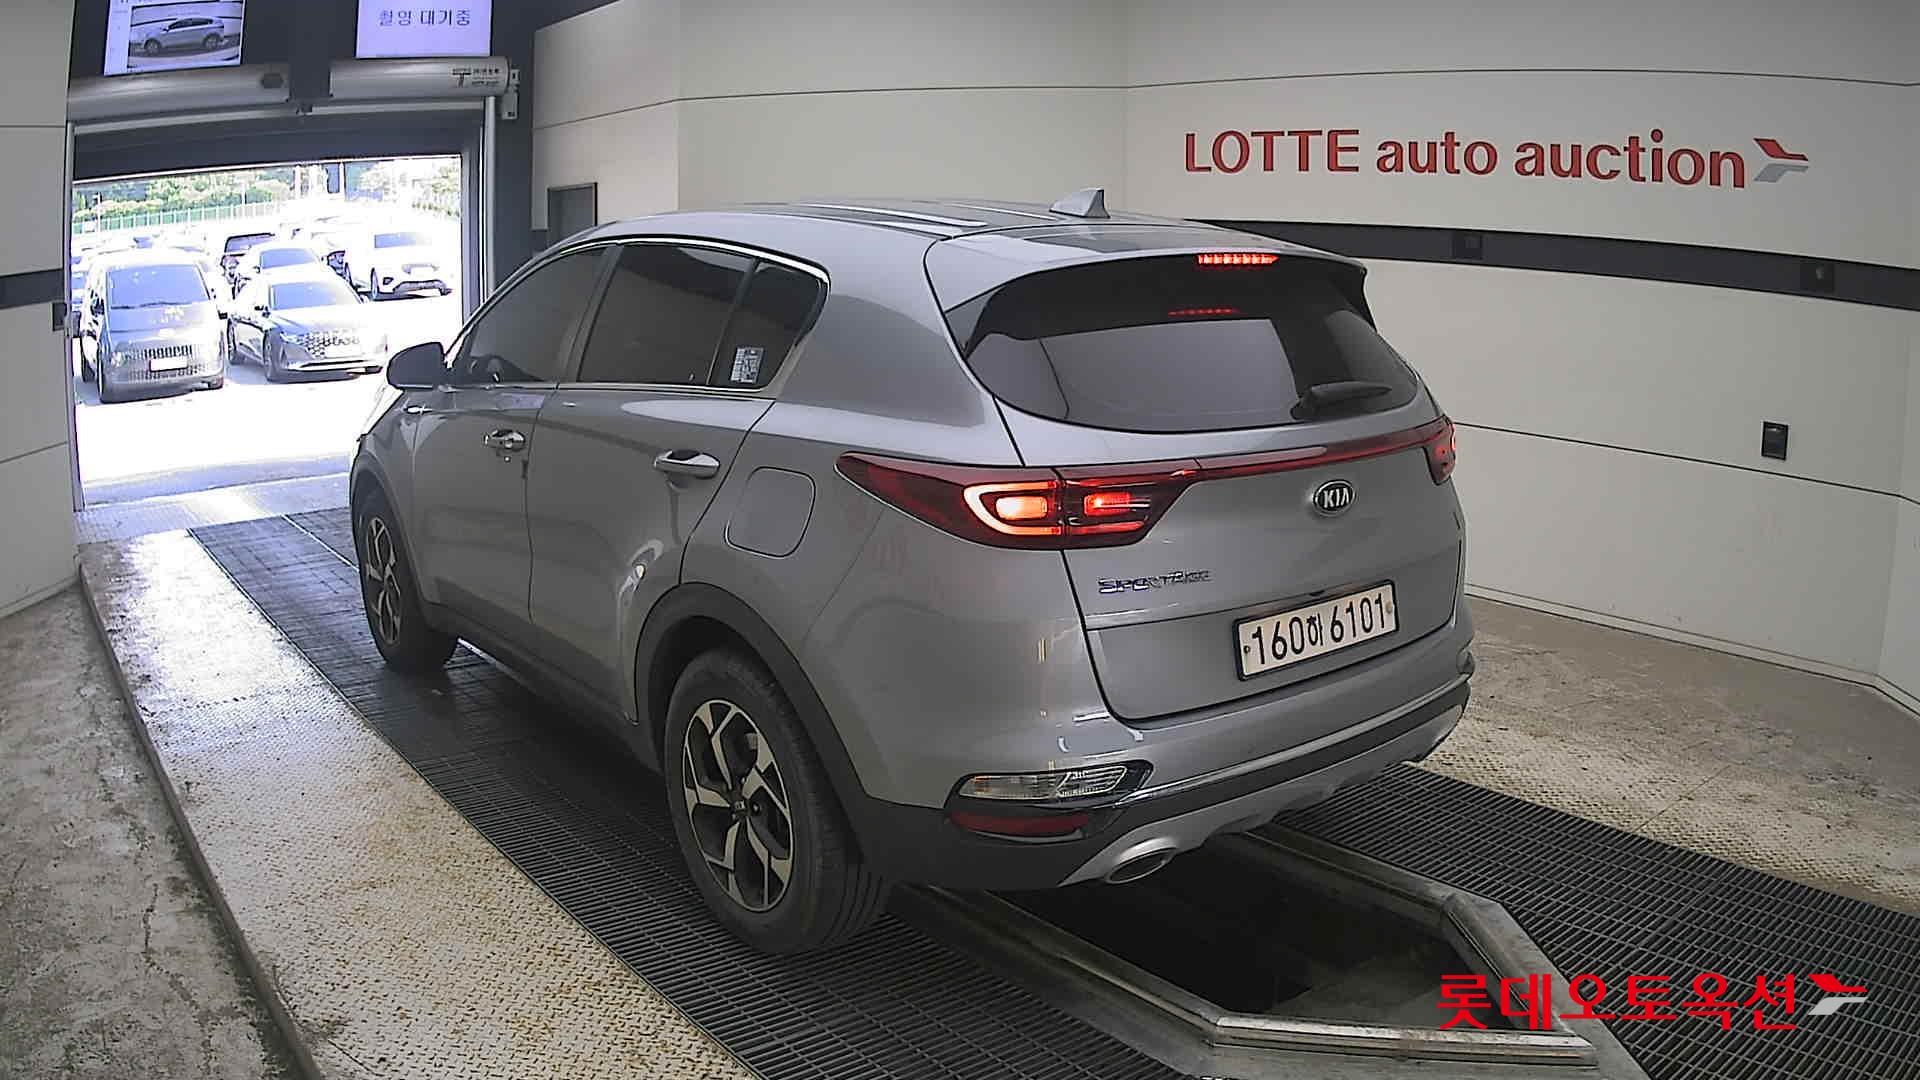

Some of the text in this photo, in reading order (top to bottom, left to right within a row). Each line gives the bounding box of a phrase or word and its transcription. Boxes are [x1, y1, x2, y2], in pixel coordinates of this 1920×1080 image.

[420, 9, 471, 27] 대기중
[1184, 129, 1746, 189] LOTTE auto auction
[1322, 487, 1350, 509] KIA
